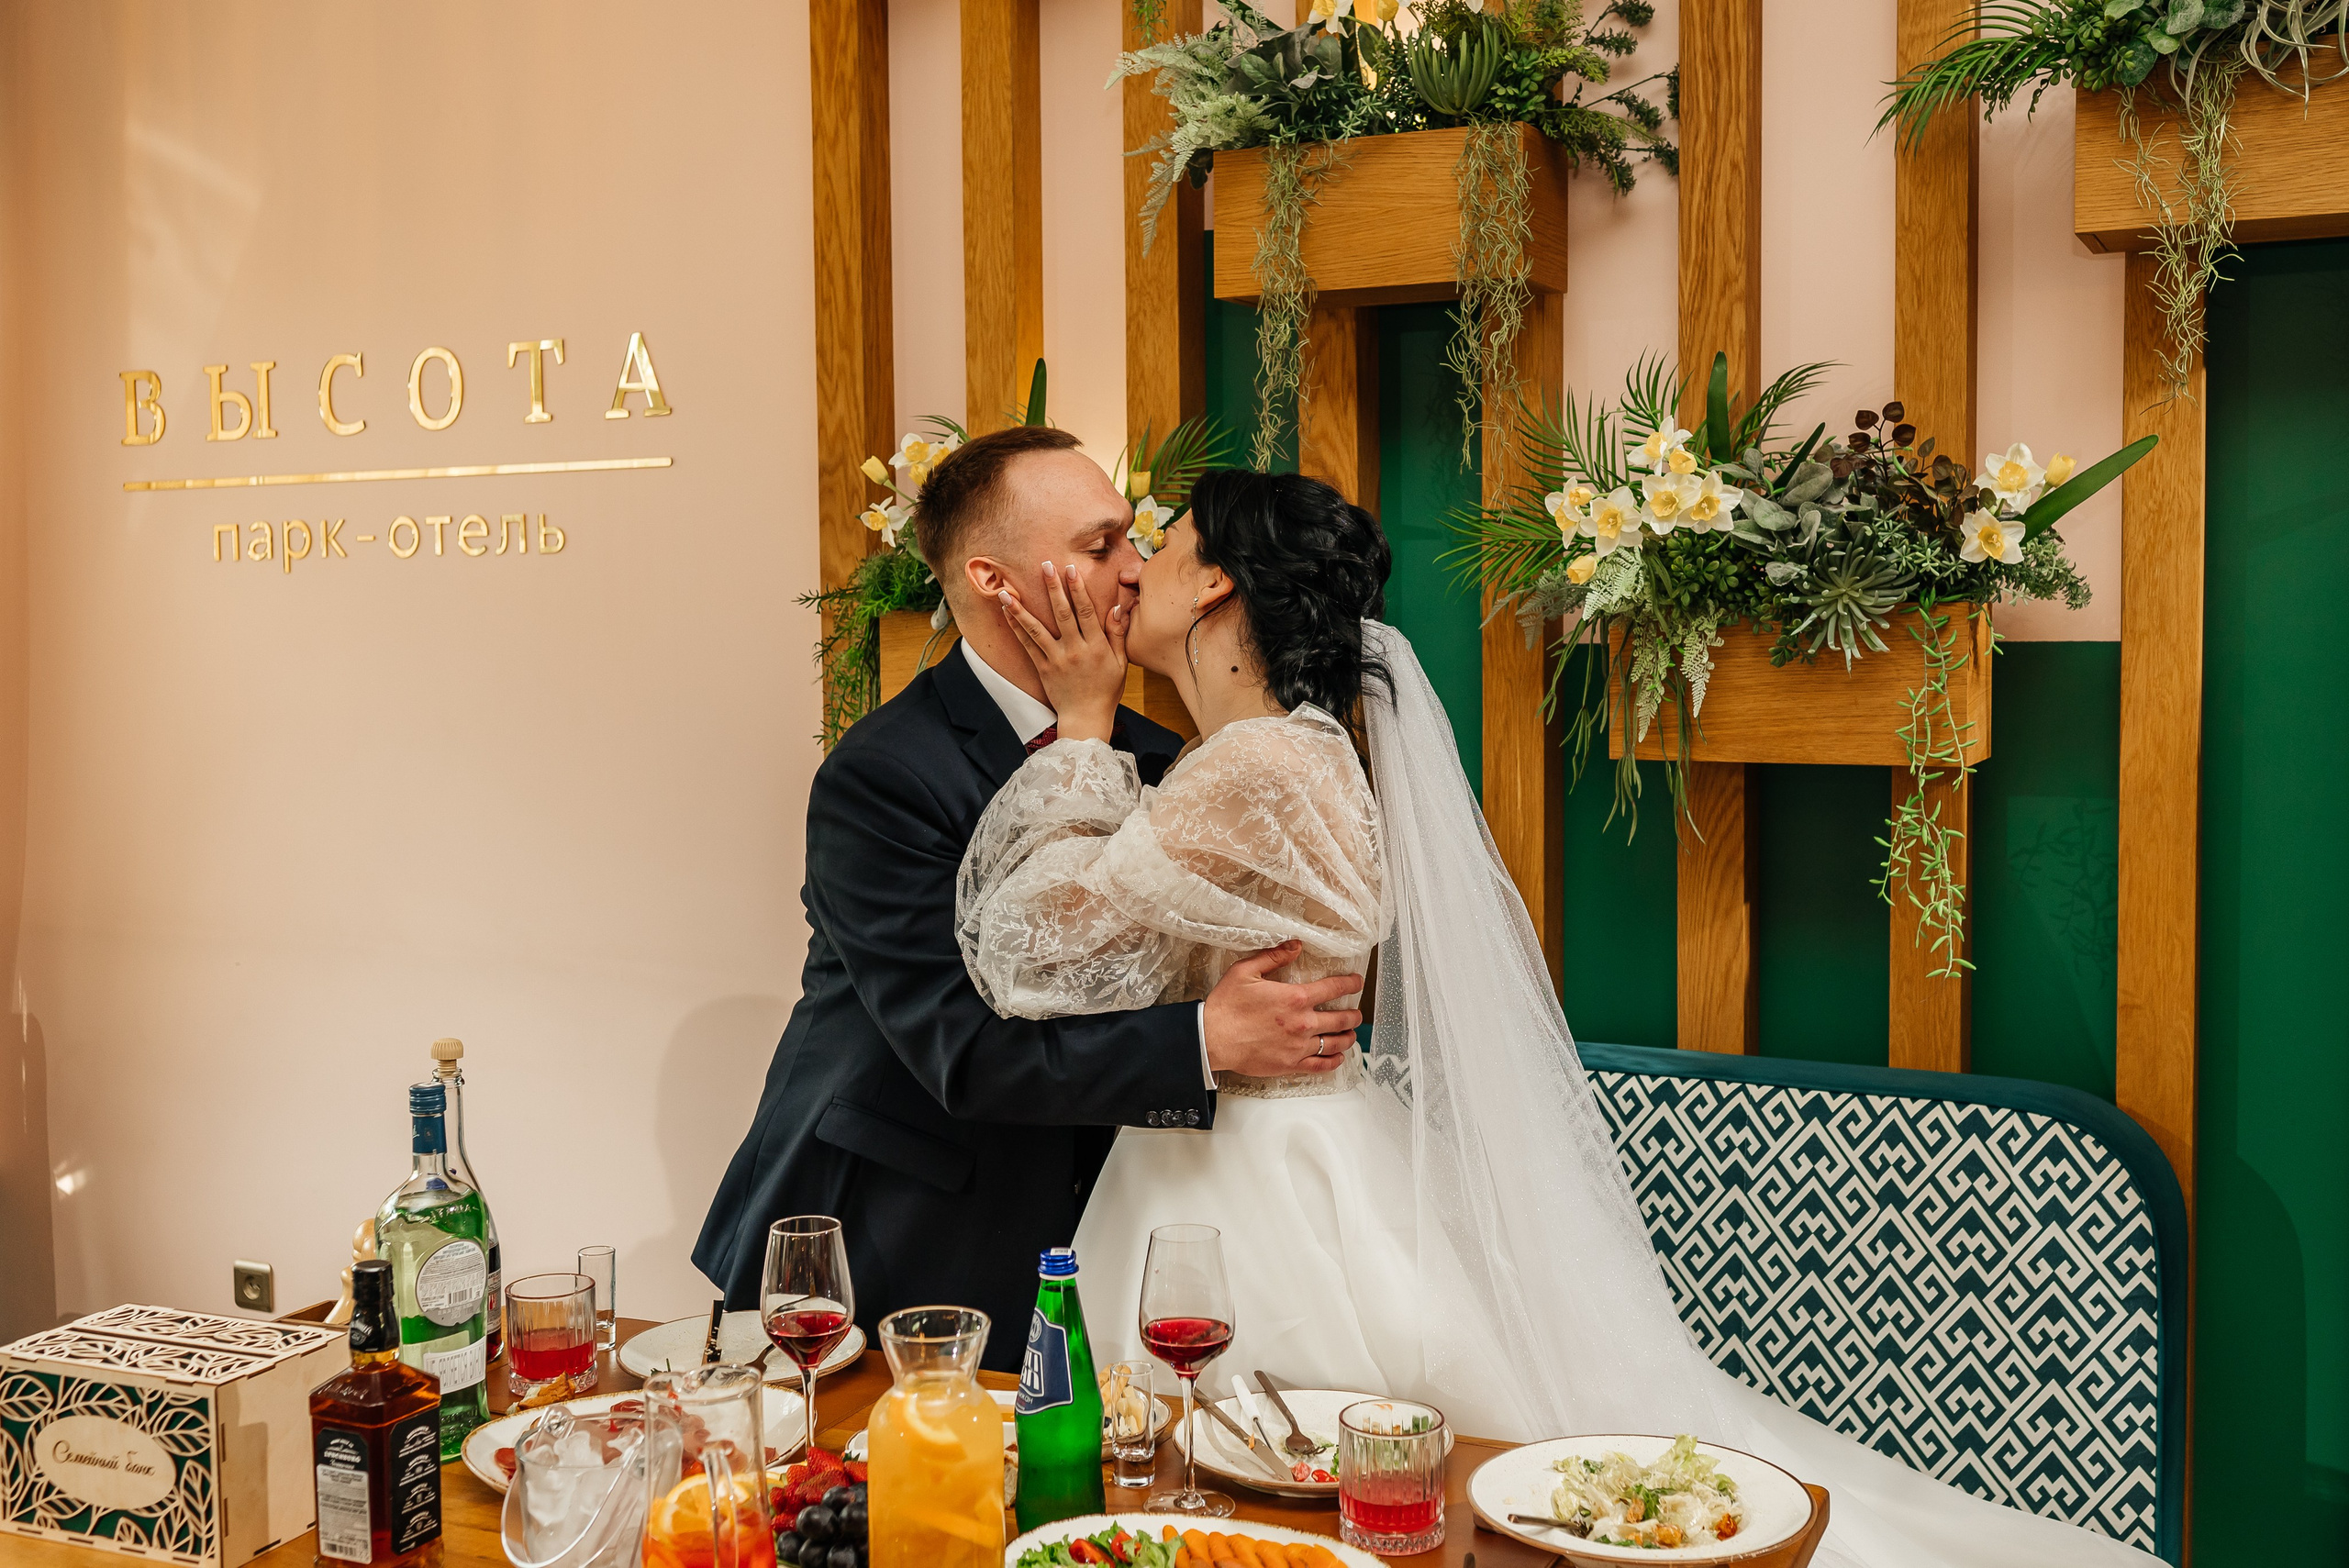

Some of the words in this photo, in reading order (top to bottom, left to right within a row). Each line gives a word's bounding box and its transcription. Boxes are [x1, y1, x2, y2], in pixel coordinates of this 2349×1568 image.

[119, 331, 673, 446] ВЫСОТА
[212, 513, 566, 573] парк-отель
[52, 1440, 119, 1470] Семейный
[125, 1451, 155, 1476] банк
